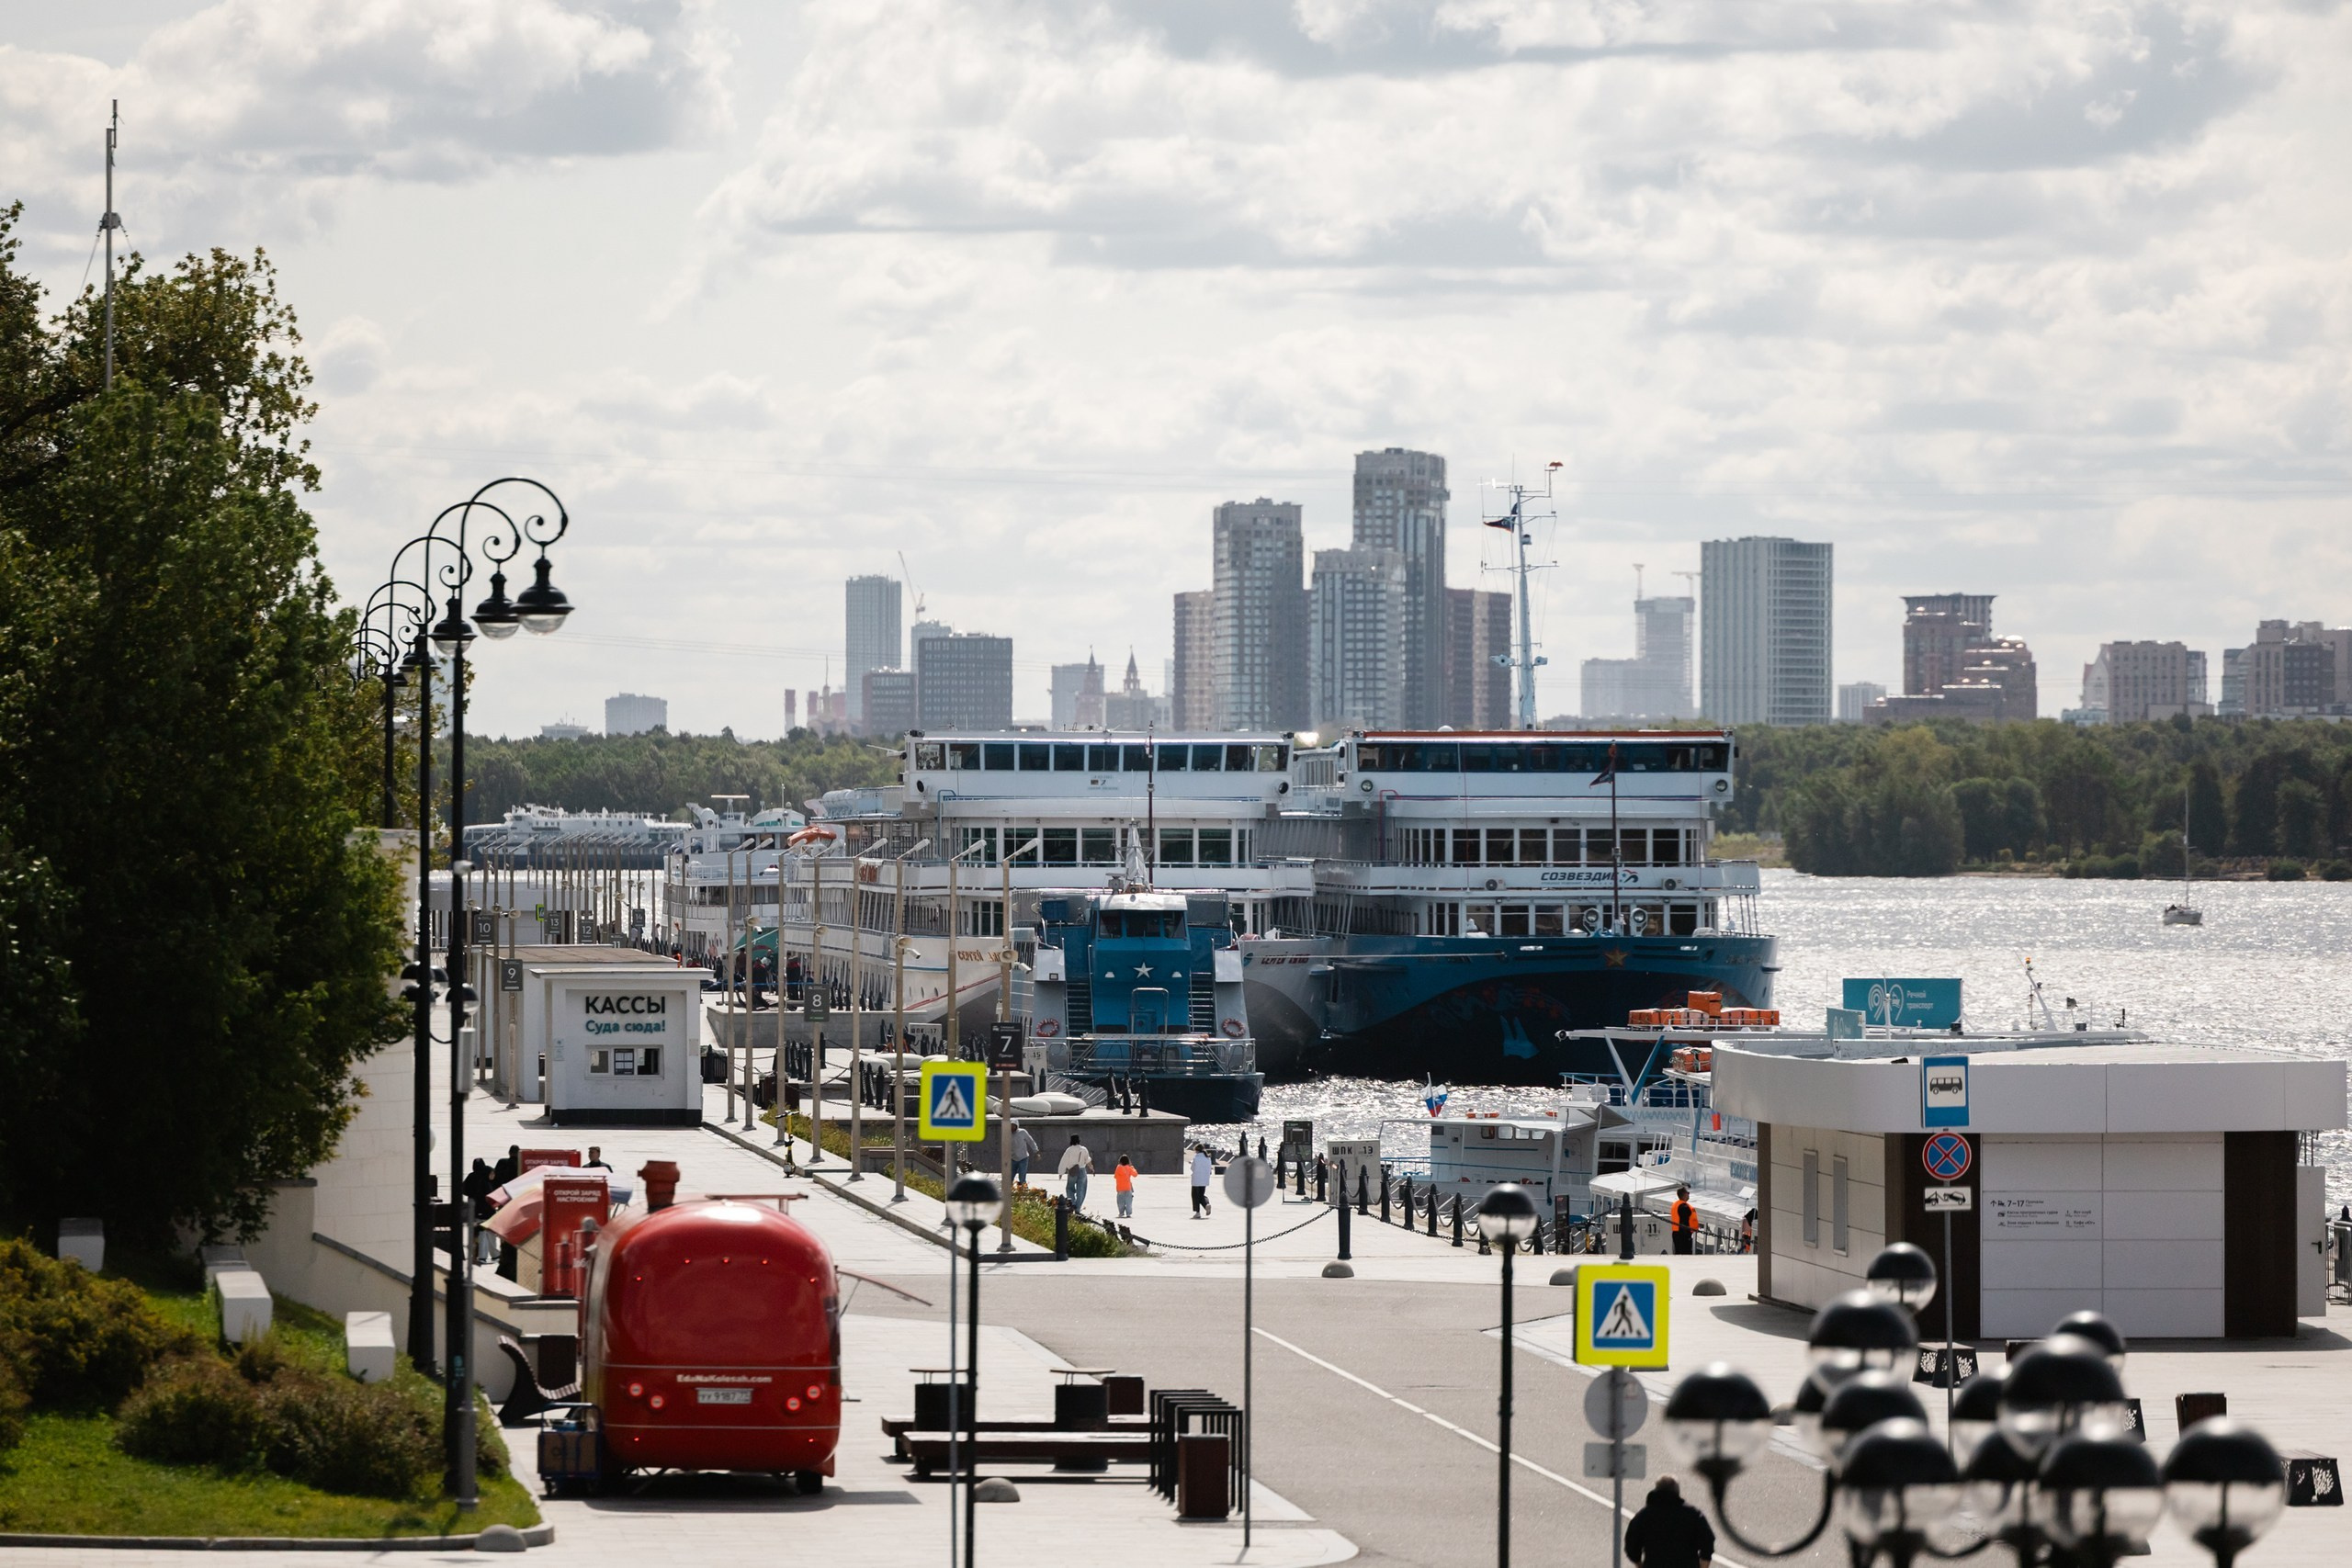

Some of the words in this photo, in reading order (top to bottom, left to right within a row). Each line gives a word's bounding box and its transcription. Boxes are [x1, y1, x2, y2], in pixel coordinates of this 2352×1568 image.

[478, 922, 491, 933] 10
[550, 918, 559, 927] 13
[582, 926, 592, 935] 12
[508, 968, 516, 979] 9
[585, 996, 665, 1014] КАССЫ
[812, 994, 821, 1007] 8
[585, 1020, 620, 1034] Суда
[625, 1020, 666, 1033] сюда!
[1001, 1035, 1012, 1053] 7
[1332, 1146, 1353, 1155] ШПК
[1612, 1224, 1637, 1234] ШК
[1647, 1224, 1657, 1234] 11
